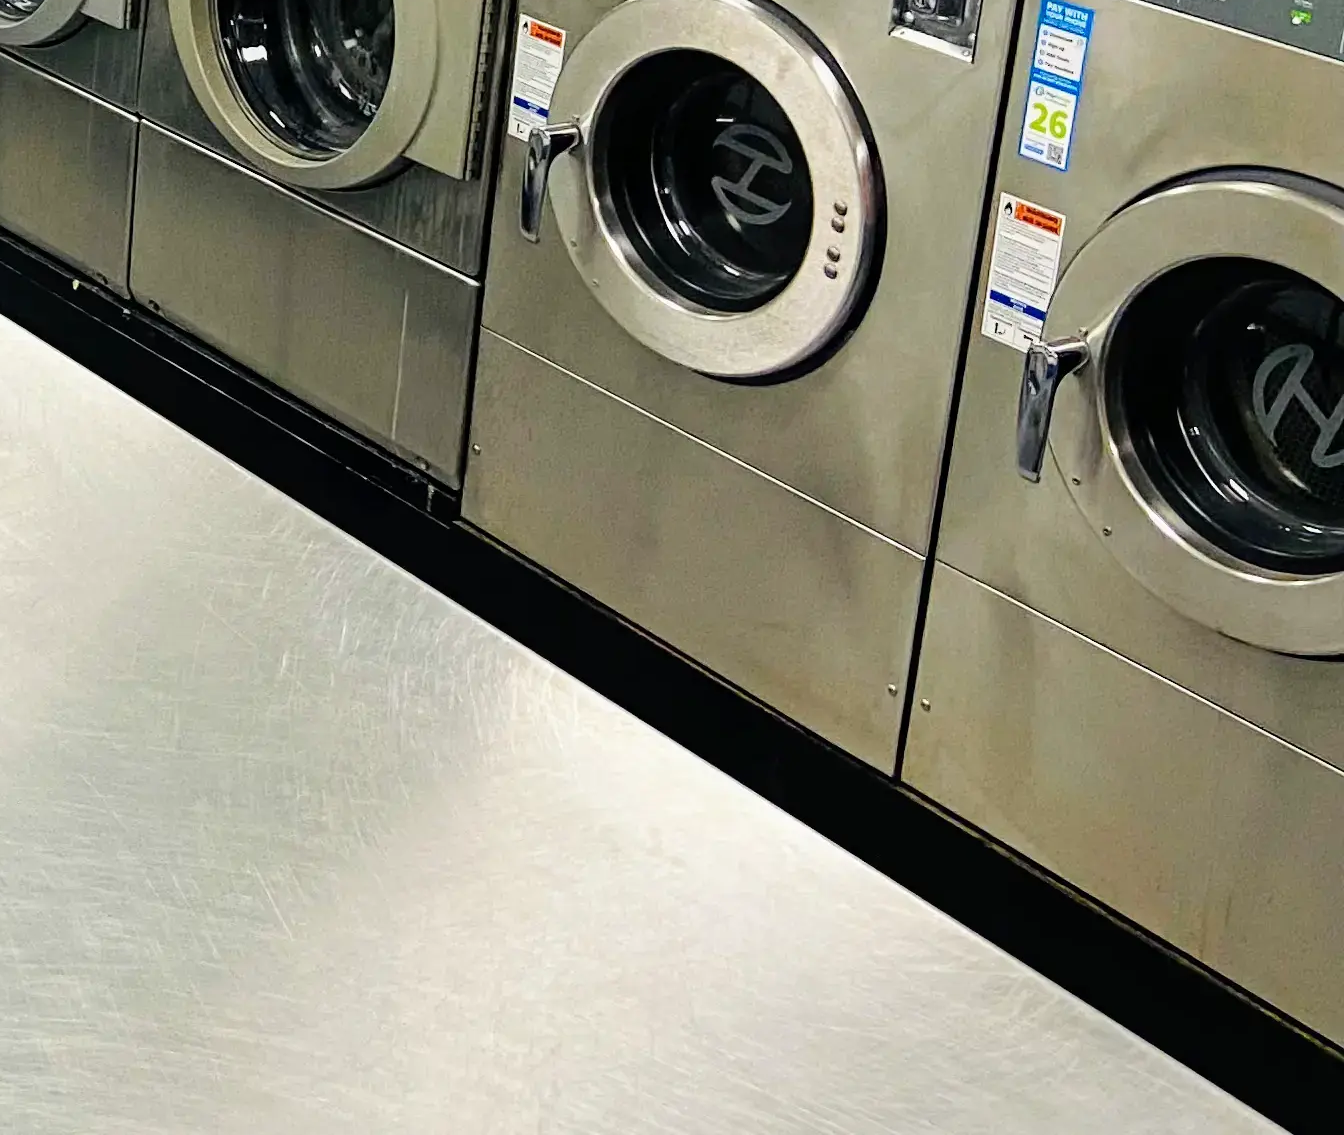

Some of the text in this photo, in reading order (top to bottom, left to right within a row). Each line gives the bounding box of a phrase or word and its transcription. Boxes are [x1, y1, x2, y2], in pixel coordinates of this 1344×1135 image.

[1047, 1, 1089, 22] PAY WITH
[1029, 103, 1068, 140] 26
